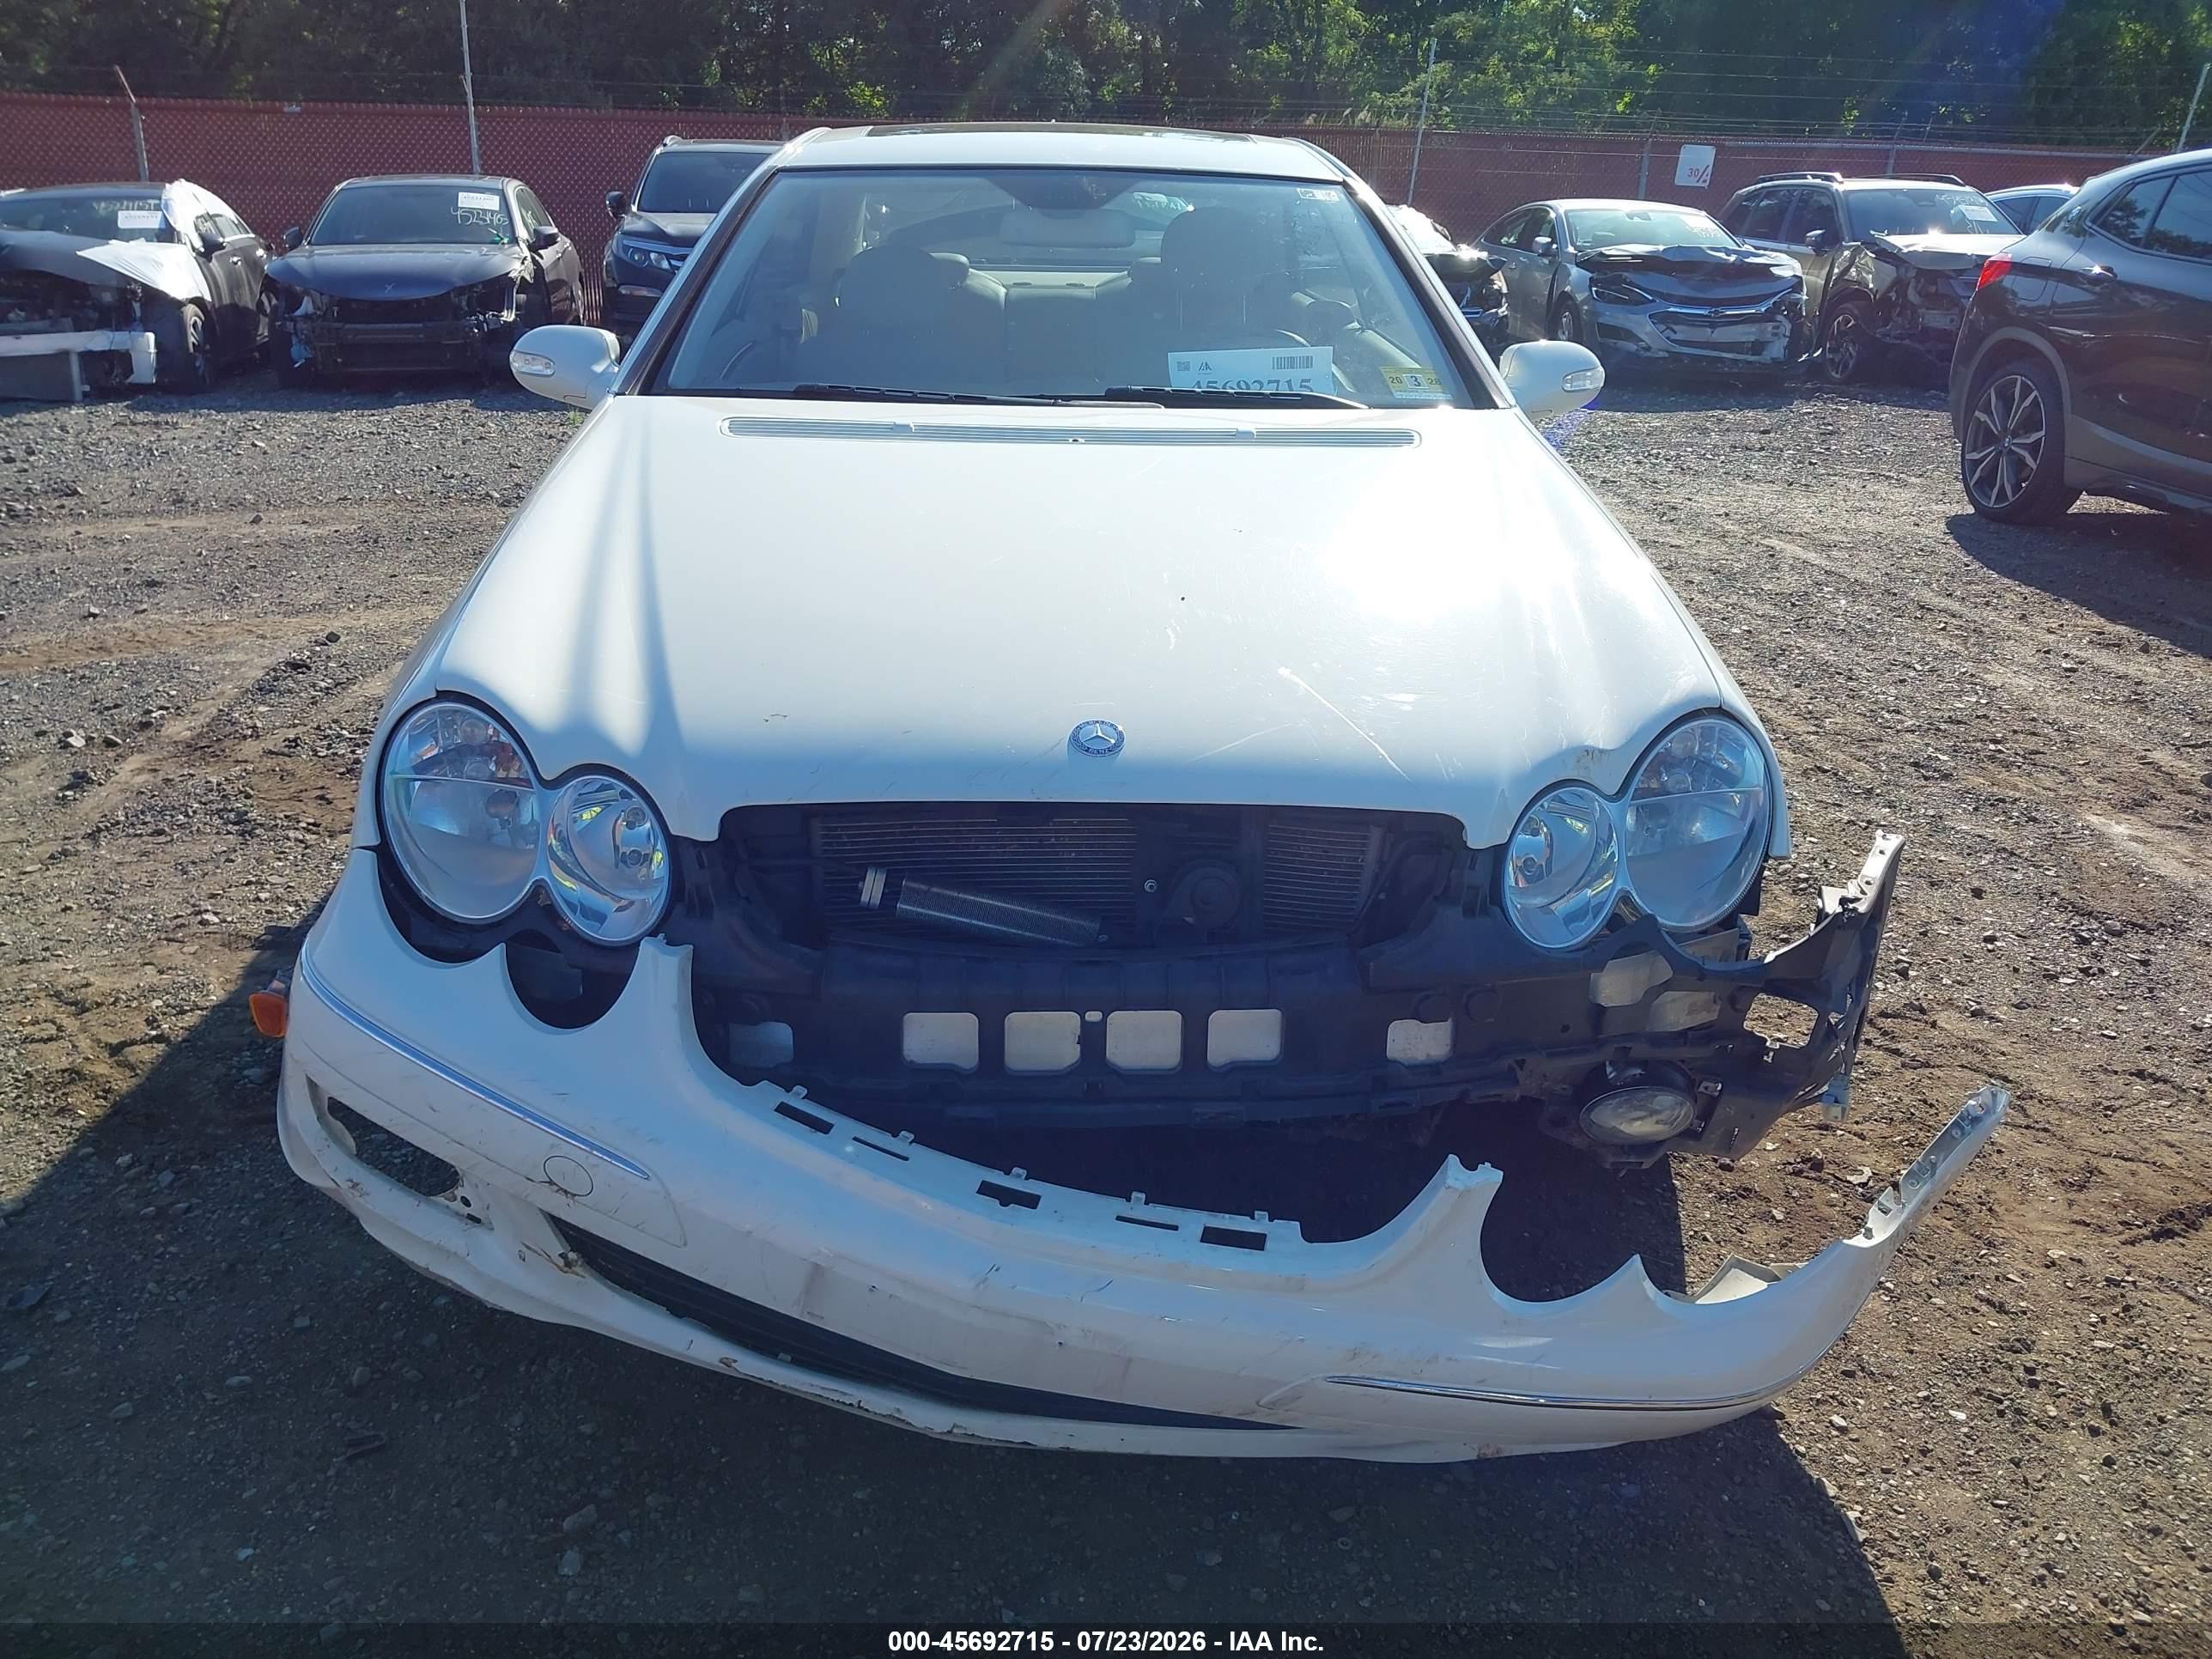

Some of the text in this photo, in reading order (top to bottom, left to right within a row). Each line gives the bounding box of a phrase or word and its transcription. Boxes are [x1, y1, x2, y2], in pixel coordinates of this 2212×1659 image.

[1687, 167, 1700, 178] 30
[1389, 376, 1403, 385] 20
[1410, 375, 1422, 387] 3
